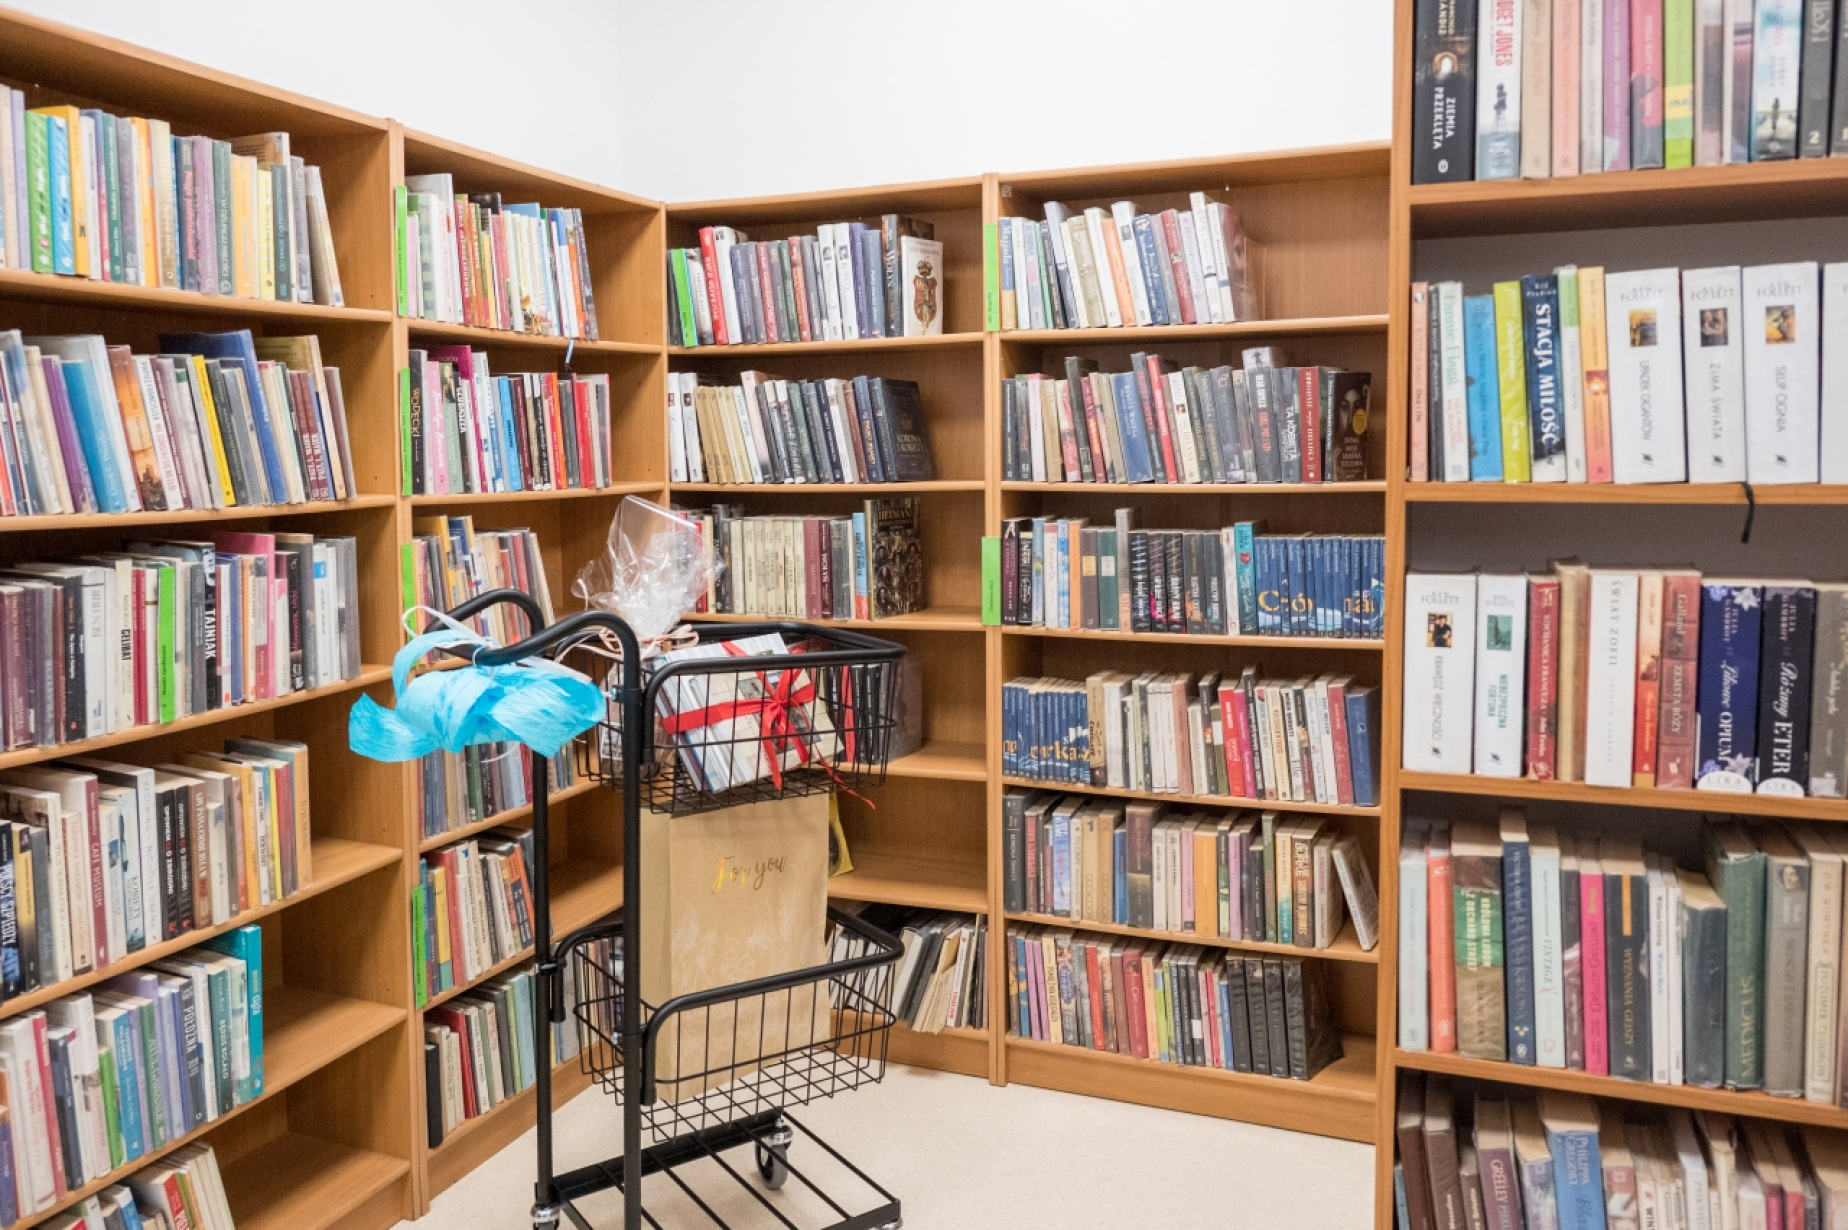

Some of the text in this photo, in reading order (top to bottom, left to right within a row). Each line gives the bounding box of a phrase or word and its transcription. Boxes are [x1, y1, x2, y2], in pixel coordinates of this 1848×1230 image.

[1495, 31, 1514, 67] JONES
[1432, 87, 1445, 150] PRZEKLĘTA
[1445, 97, 1456, 138] ZIEMIA
[1532, 304, 1554, 368] STACJA
[145, 383, 162, 422] FRANCISZEK
[410, 387, 421, 438] WODECKI
[1539, 374, 1560, 446] MIŁOŚĆ
[1640, 360, 1654, 442] UPADEK GIGANTÓW
[1710, 364, 1725, 440] ZIMA ŚWIATA
[1775, 366, 1788, 432] SŁUP OGNIA
[435, 431, 446, 469] Monroe
[1285, 406, 1298, 461] TA KOBIETA
[92, 590, 102, 638] BEN HUR
[1420, 595, 1460, 605] FOLLETT
[1609, 580, 1622, 621] ŚWIAT
[1723, 598, 1732, 642] GAMBROT
[1730, 608, 1739, 634] JULIA
[1779, 595, 1790, 642] GAMBROT
[1788, 604, 1797, 632] JULIA
[205, 608, 217, 660] TAJNIAK
[1608, 628, 1620, 666] ZOFII
[1540, 666, 1550, 710] FRANCUZA
[1672, 594, 1688, 734] Galland ZEMSTA RÓŻY
[1430, 655, 1444, 740] KRAWĘDŹ WIECZNOŚCI
[1488, 684, 1498, 717] FORTUNA
[1498, 674, 1508, 730] NIEBEZPIECZNA
[1772, 662, 1798, 774] Różany ETER
[1718, 712, 1734, 762] OPIUM
[142, 780, 158, 930] BECOMING MICHELLE OBAMA
[167, 858, 175, 895] ZBRODNI
[180, 855, 188, 892] ZBRODNI
[711, 853, 788, 894] For you
[1295, 843, 1304, 878] BURKE
[0, 864, 16, 946] POLSCY SZPIEDZY
[94, 866, 104, 908] MUSEUM
[1656, 895, 1664, 920] William
[1466, 900, 1478, 939] ORCHARD
[1481, 898, 1494, 970] KRÓLOWA LODÓW
[1656, 921, 1664, 946] Golding
[1821, 898, 1832, 955] GORTNER
[1467, 941, 1478, 973] STREET
[1542, 939, 1554, 984] VINTAGE
[1623, 948, 1634, 1047] WYZNANIA GEJSZY
[182, 1005, 198, 1054] POŁOŻNA
[1740, 976, 1756, 1078] MEDICUS
[1817, 970, 1830, 1078] POTOMEK TUDORÓW
[218, 1019, 230, 1080] BĘDZIE BOLAŁO
[1490, 1160, 1508, 1204] GREELEY
[1565, 1136, 1578, 1185] GREGORY
[1578, 1137, 1590, 1185] PHILIPPA
